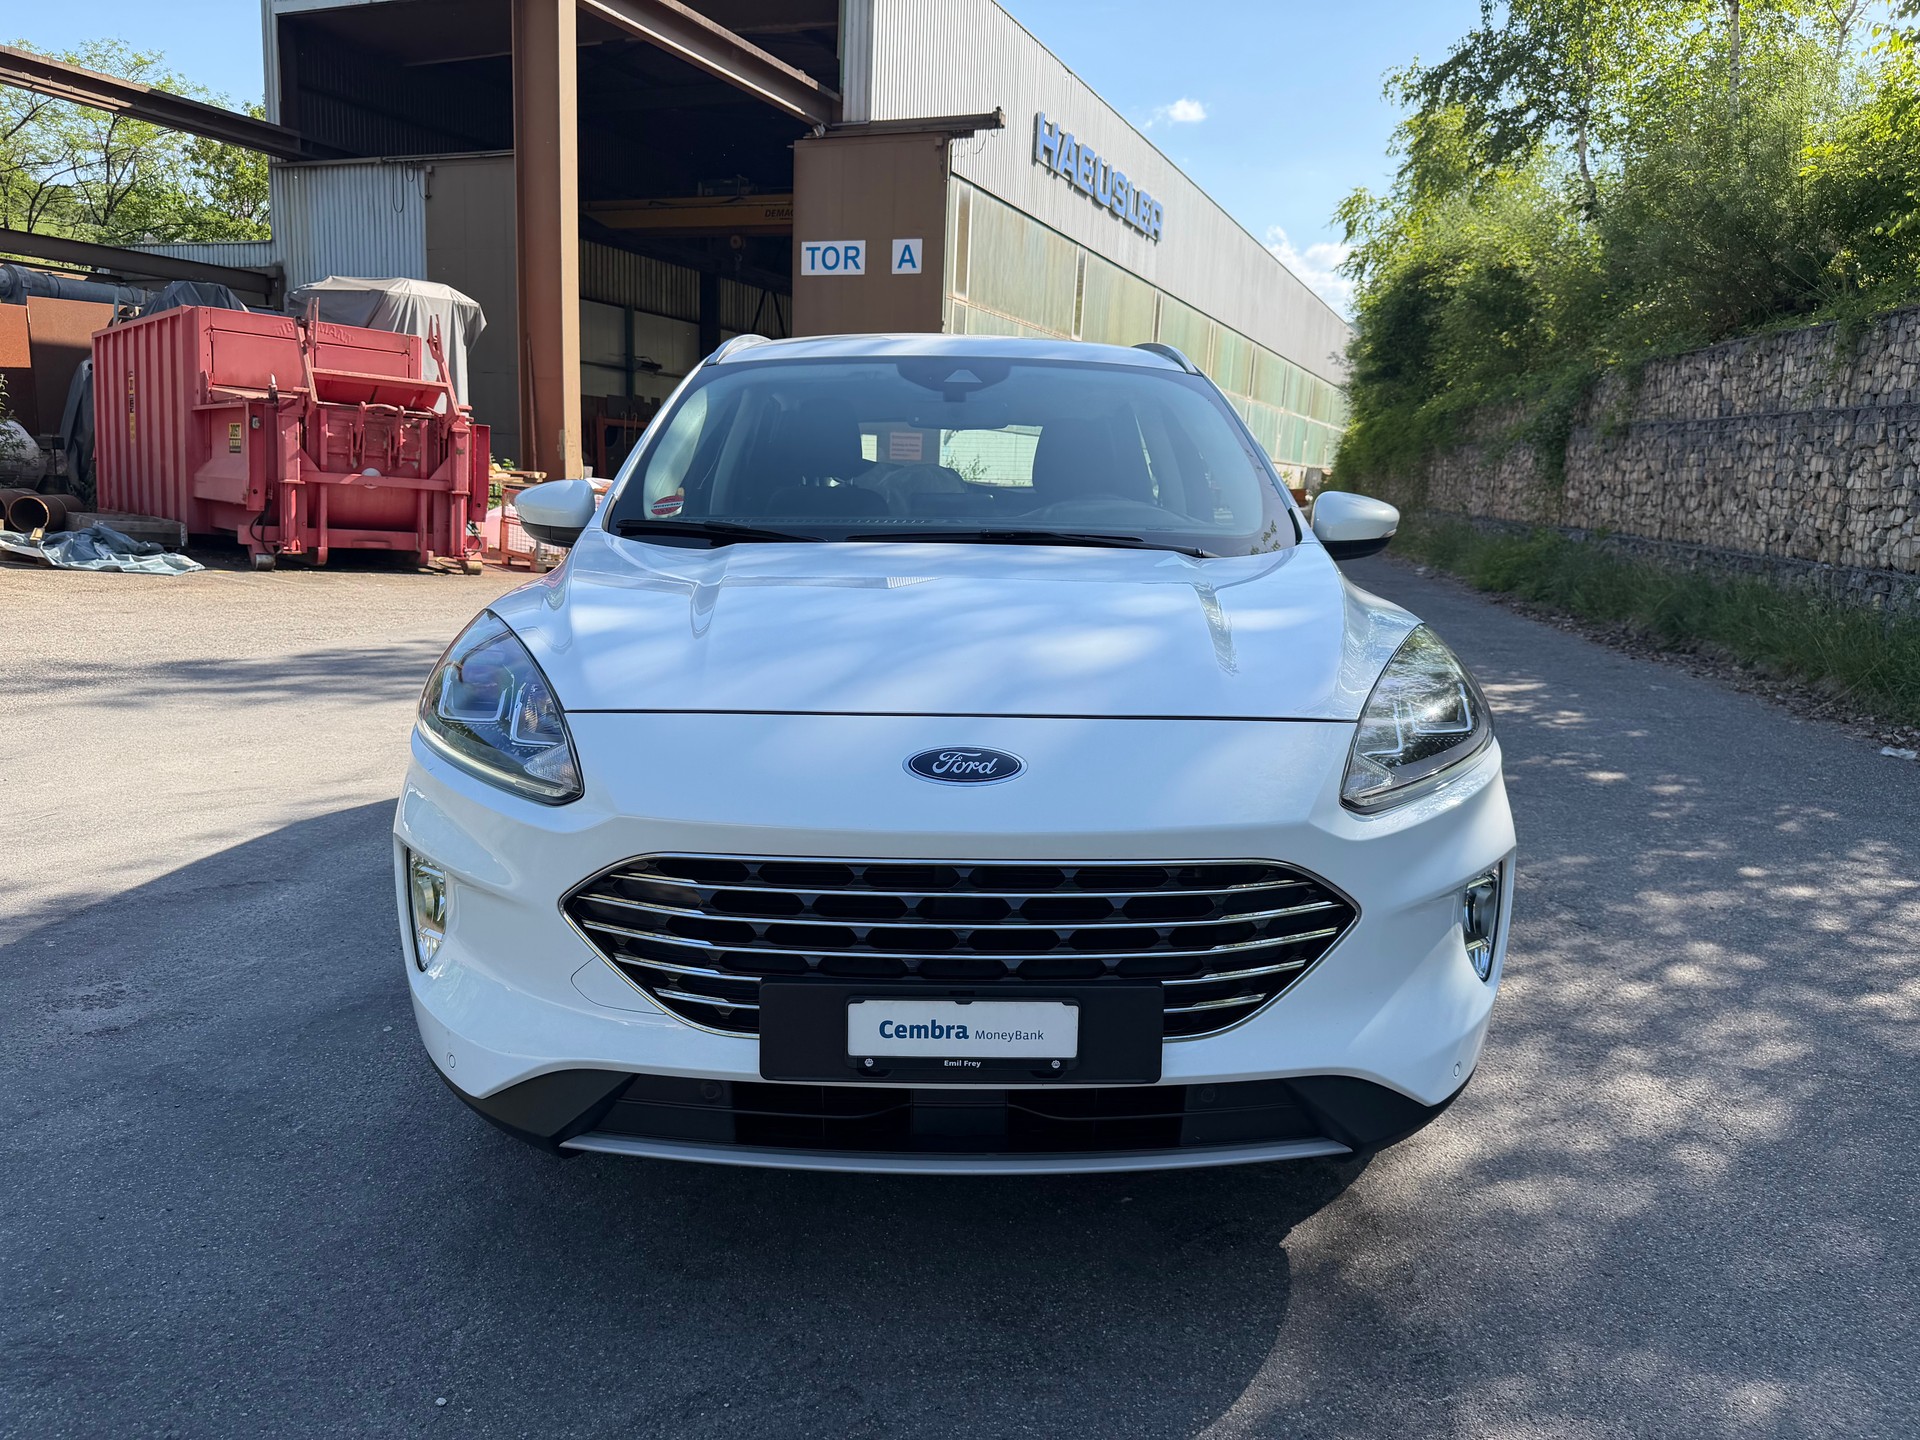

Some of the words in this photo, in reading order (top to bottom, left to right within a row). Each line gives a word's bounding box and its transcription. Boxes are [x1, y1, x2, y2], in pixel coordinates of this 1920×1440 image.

[1033, 111, 1163, 241] HAEUSLER
[805, 245, 861, 270] TOR
[896, 244, 917, 269] A
[932, 751, 998, 774] Ford
[879, 1019, 970, 1040] Cembra
[974, 1029, 1044, 1042] MoneyBank
[943, 1059, 962, 1067] Emil
[964, 1060, 981, 1068] Frey
